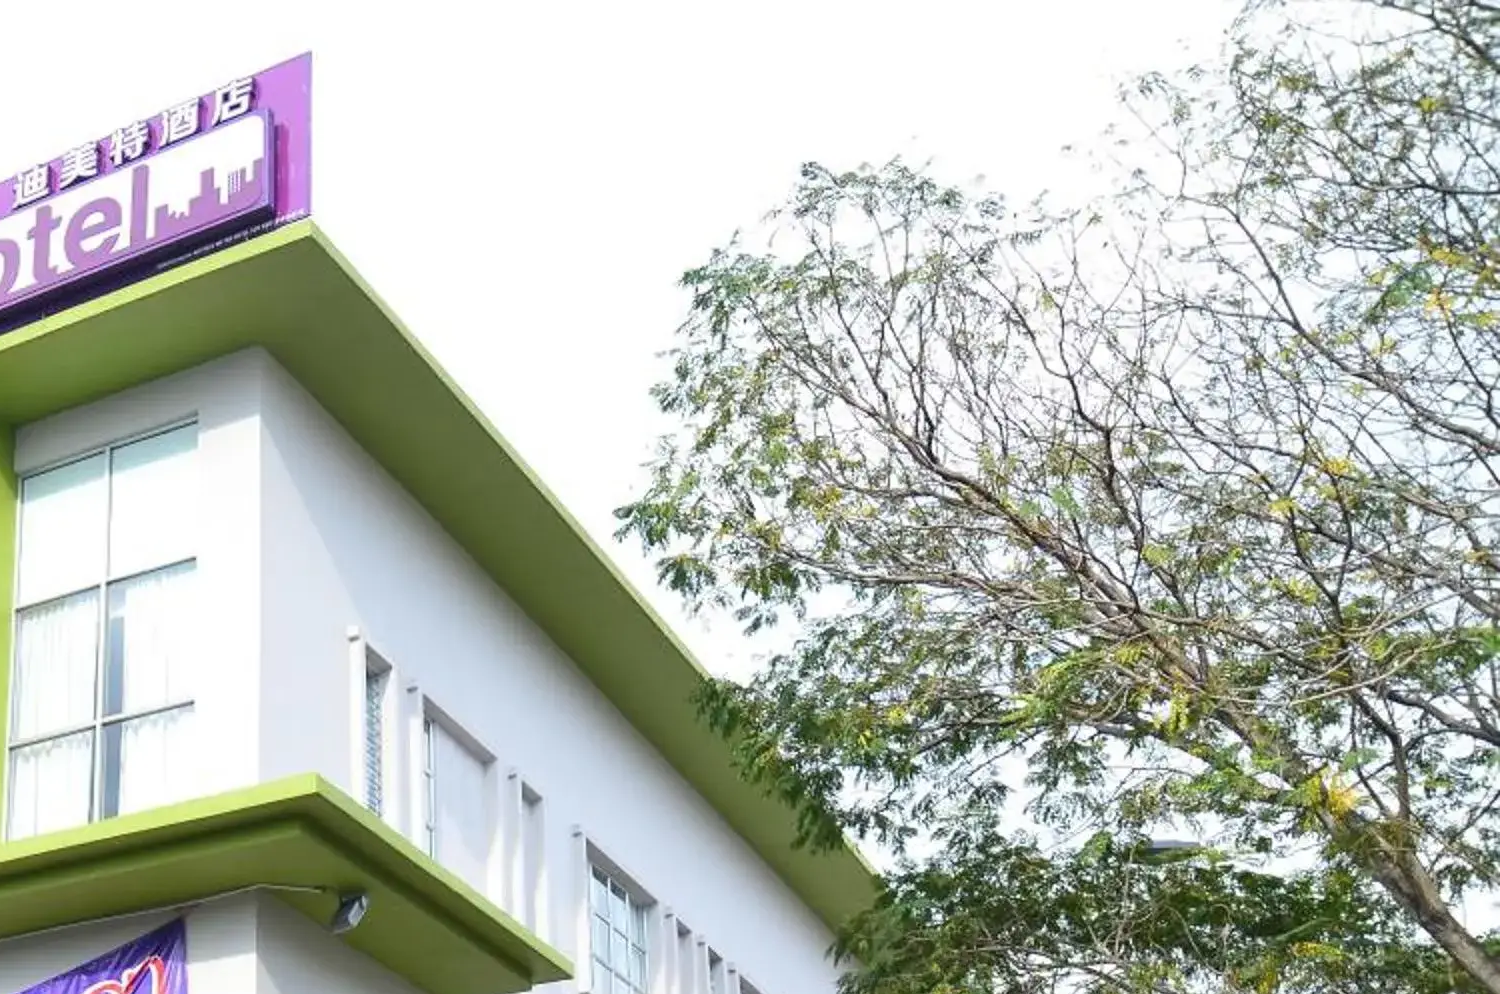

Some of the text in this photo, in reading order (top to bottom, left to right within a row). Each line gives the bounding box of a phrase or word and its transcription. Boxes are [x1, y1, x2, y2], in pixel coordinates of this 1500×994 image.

[13, 77, 254, 204] 迪美特酒店
